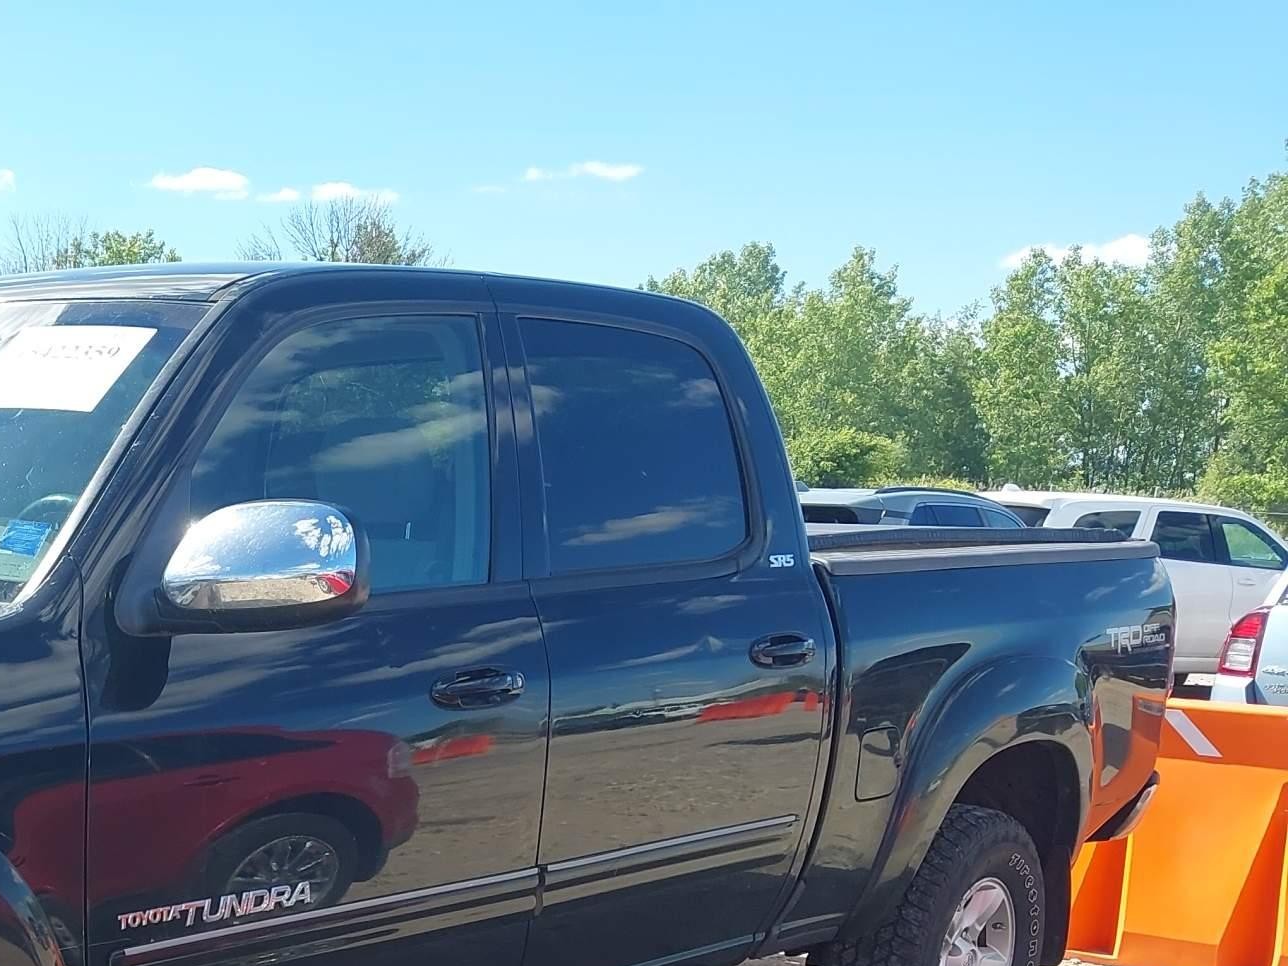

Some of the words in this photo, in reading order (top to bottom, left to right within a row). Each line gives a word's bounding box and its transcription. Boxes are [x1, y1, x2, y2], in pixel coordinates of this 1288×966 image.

[769, 554, 795, 568] SR5
[1106, 625, 1143, 654] TRD
[1142, 633, 1166, 644] ROAD
[117, 904, 182, 930] TOYOTA
[182, 880, 314, 927] TUNDRA
